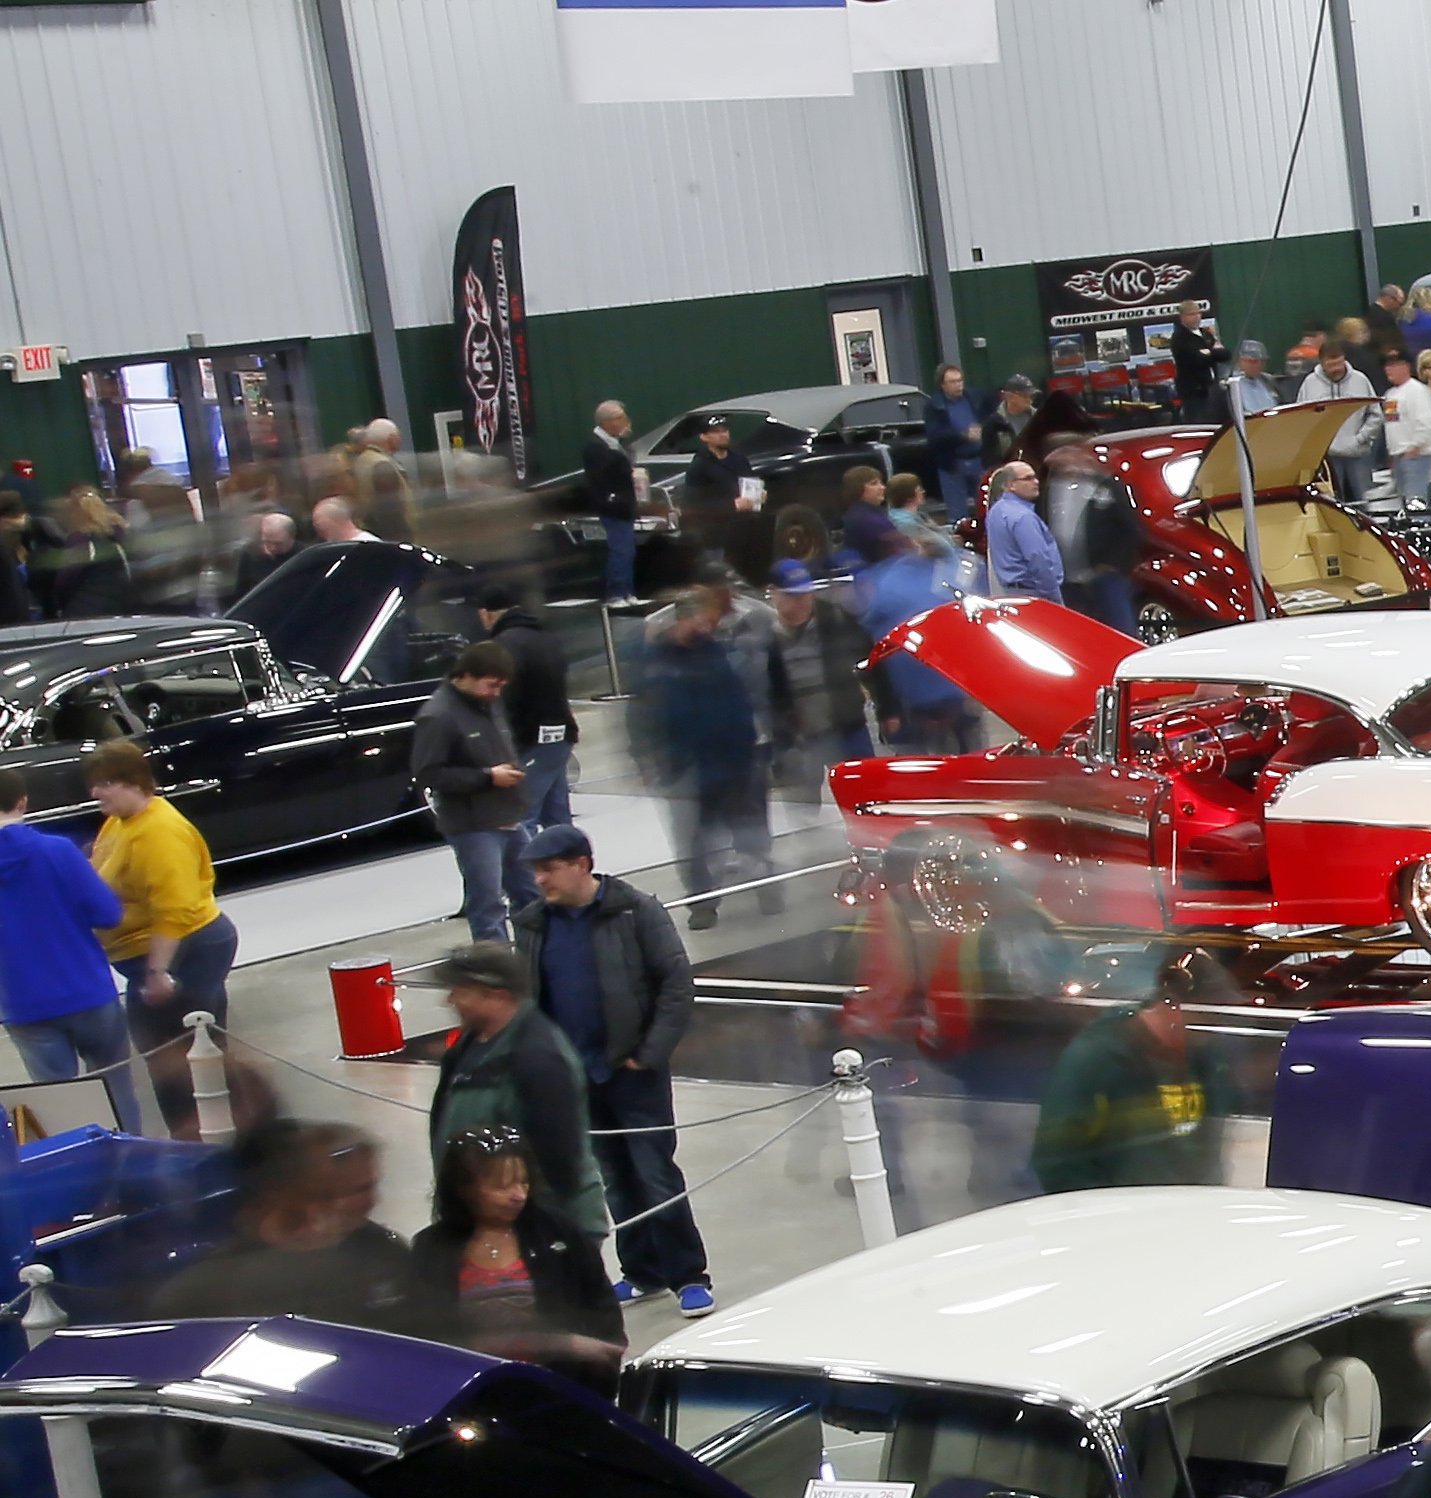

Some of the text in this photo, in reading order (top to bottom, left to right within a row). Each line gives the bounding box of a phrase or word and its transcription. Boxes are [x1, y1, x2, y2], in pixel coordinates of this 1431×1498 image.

[1110, 269, 1149, 295] MRC
[1055, 312, 1114, 326] MIDWEST
[1118, 309, 1143, 319] ROD
[22, 347, 52, 371] EXIT
[471, 330, 497, 391] MRC
